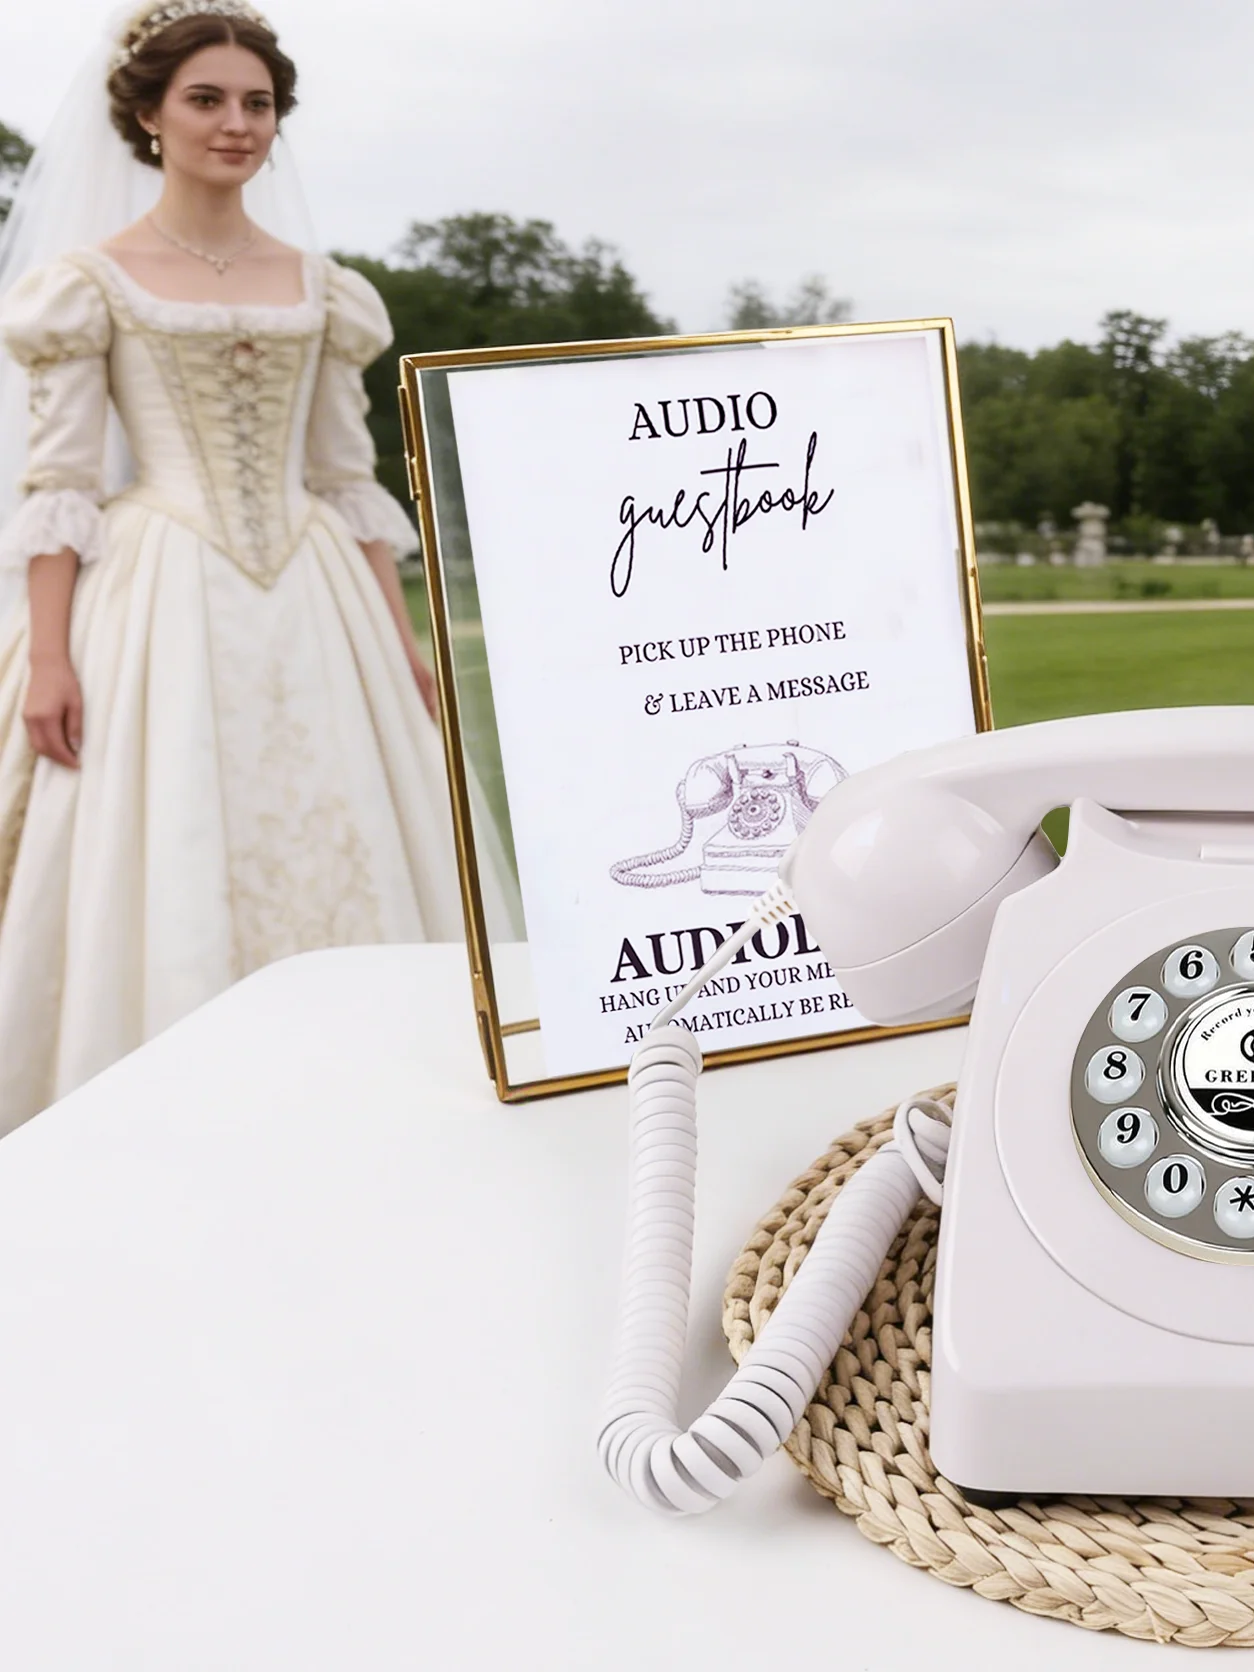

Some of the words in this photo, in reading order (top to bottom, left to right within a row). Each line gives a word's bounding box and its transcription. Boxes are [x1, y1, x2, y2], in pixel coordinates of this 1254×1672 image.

[628, 391, 778, 440] AUDIO
[610, 432, 834, 598] guestbook
[619, 640, 675, 665] PICK
[679, 637, 710, 658] UP
[715, 631, 762, 654] THE
[766, 621, 846, 648] PHONE
[644, 693, 664, 715] &
[670, 686, 742, 712] LEAVE
[746, 685, 763, 703] A
[766, 671, 870, 700] MESSAGE
[1179, 950, 1203, 980] 6
[599, 988, 661, 1013] HANG
[664, 983, 688, 1003] U
[697, 976, 741, 999] AND
[744, 966, 802, 990] YOUR
[1127, 993, 1151, 1022] 7
[624, 1000, 795, 1044] AUMATICALLY
[799, 996, 824, 1015] BE
[1200, 1007, 1242, 1041] Record
[1103, 1050, 1127, 1080] 8
[1116, 1112, 1141, 1144] 9
[1162, 1163, 1188, 1194] 0
